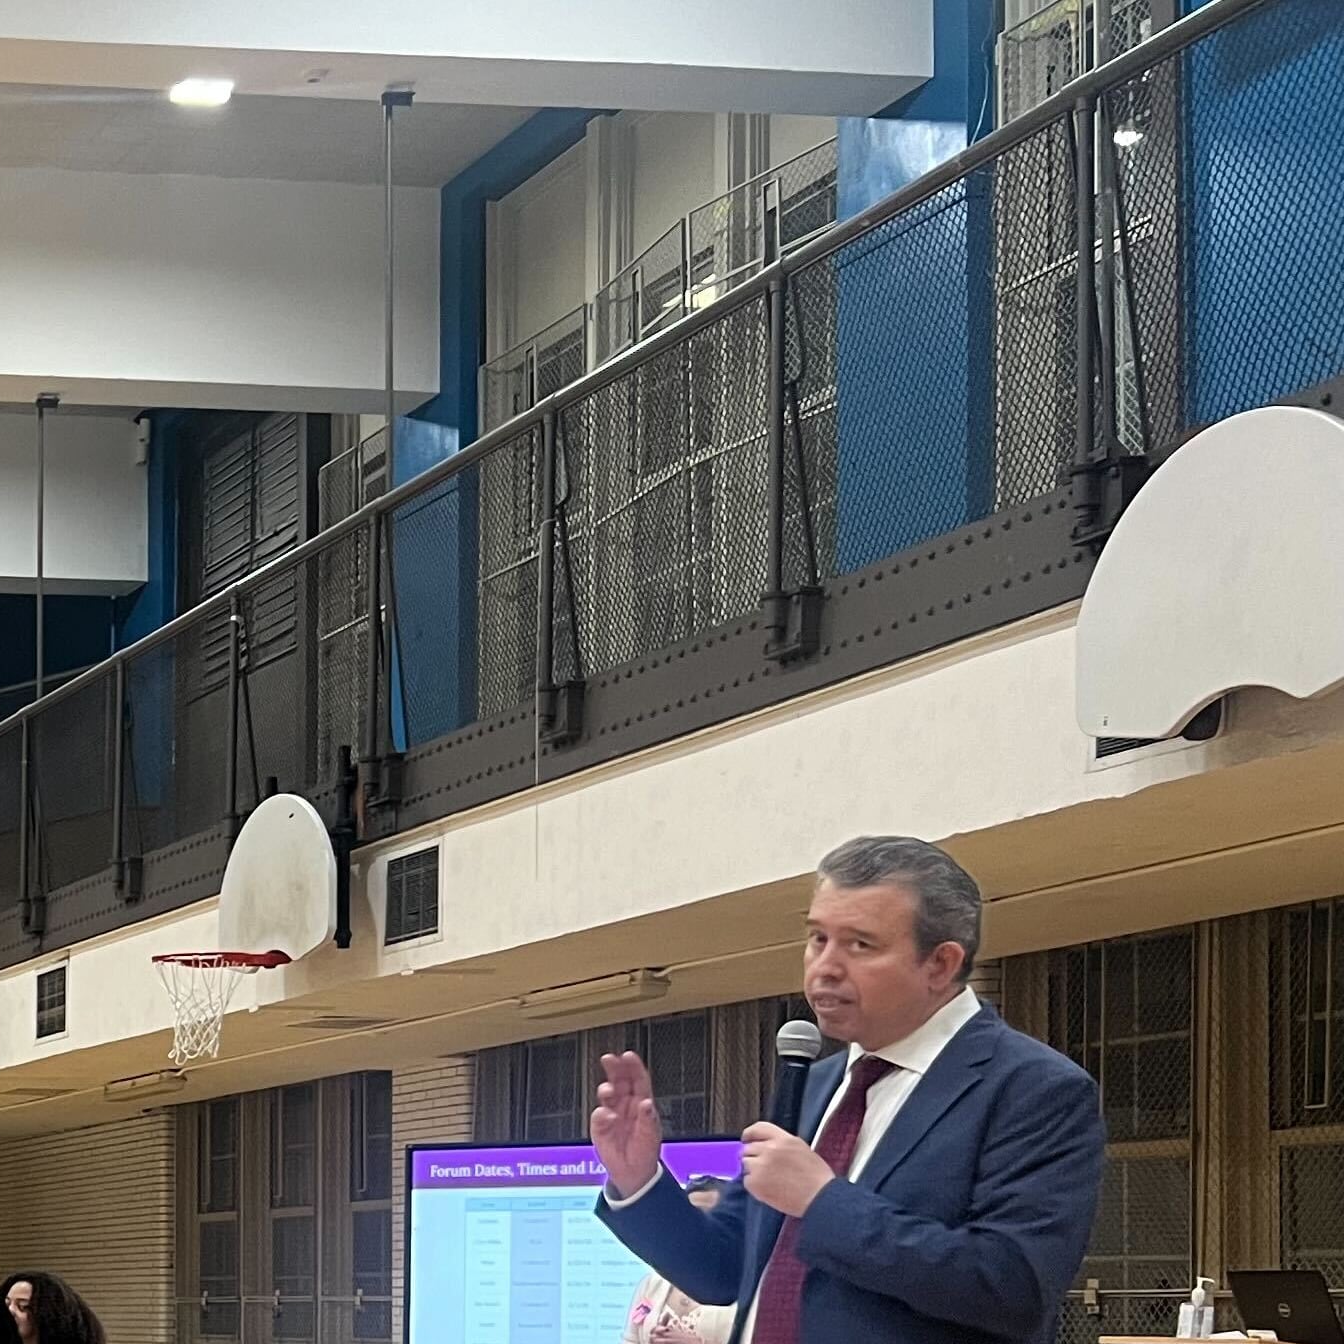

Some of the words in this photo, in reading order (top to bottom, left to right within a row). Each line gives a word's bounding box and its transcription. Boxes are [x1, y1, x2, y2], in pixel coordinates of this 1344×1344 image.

[430, 1164, 471, 1178] Forum
[475, 1164, 515, 1178] Dates,
[517, 1162, 556, 1177] Times
[560, 1161, 585, 1175] and
